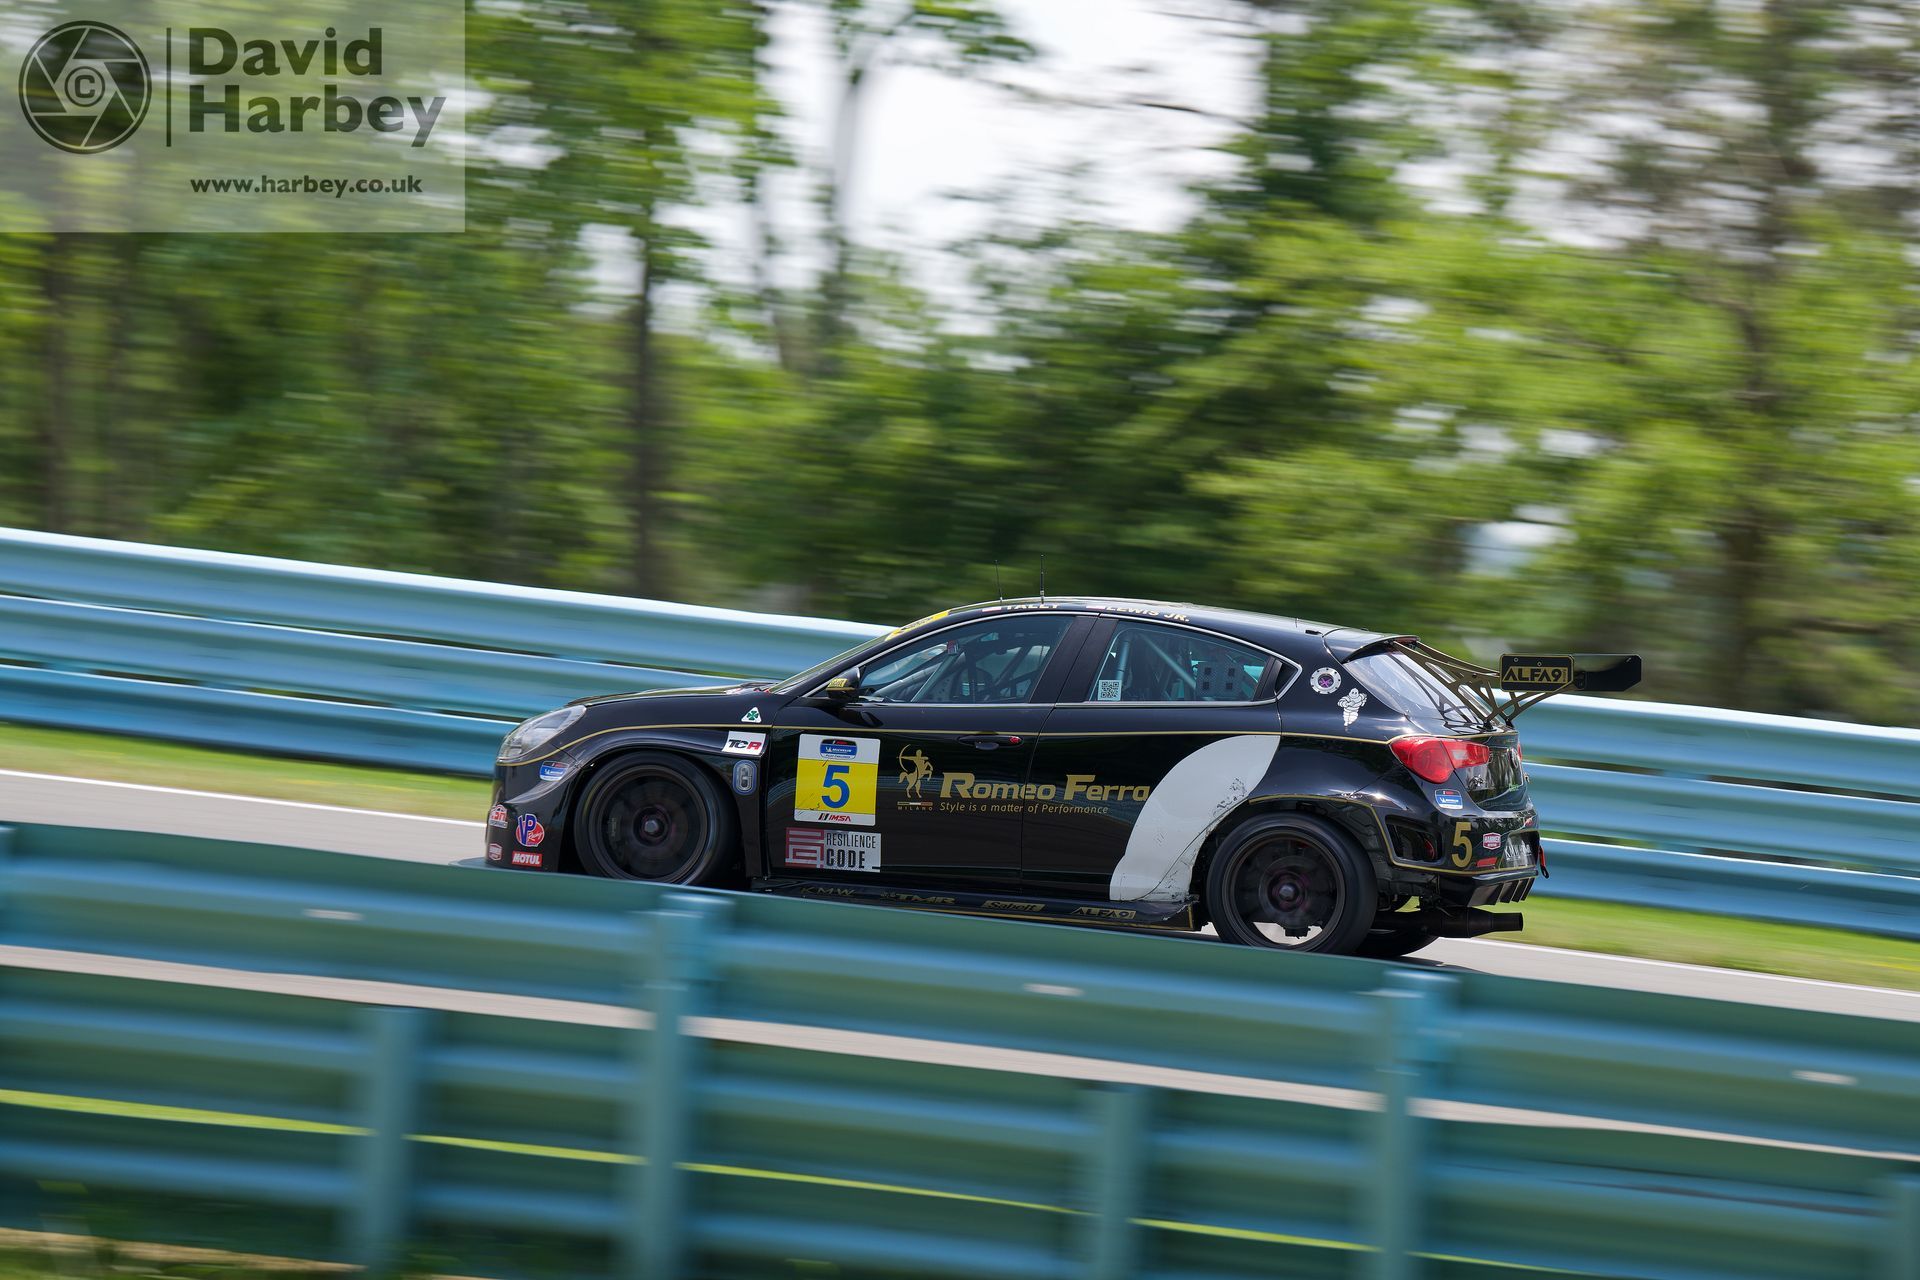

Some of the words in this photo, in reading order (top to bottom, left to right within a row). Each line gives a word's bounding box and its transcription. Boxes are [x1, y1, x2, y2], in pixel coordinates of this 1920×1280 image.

[1105, 606, 1160, 617] LEWIS
[728, 739, 762, 750] TCR
[821, 765, 850, 809] 5
[940, 772, 1056, 800] Romeo
[940, 802, 966, 813] Style
[990, 803, 1024, 812] matter
[1027, 804, 1038, 814] of
[1042, 804, 1109, 814] Performance
[828, 814, 851, 822] IMSA
[518, 813, 538, 845] VP
[826, 833, 876, 849] RESILIENCE
[1451, 821, 1473, 868] 5
[512, 853, 540, 865] MOTUL
[826, 848, 866, 869] CODE
